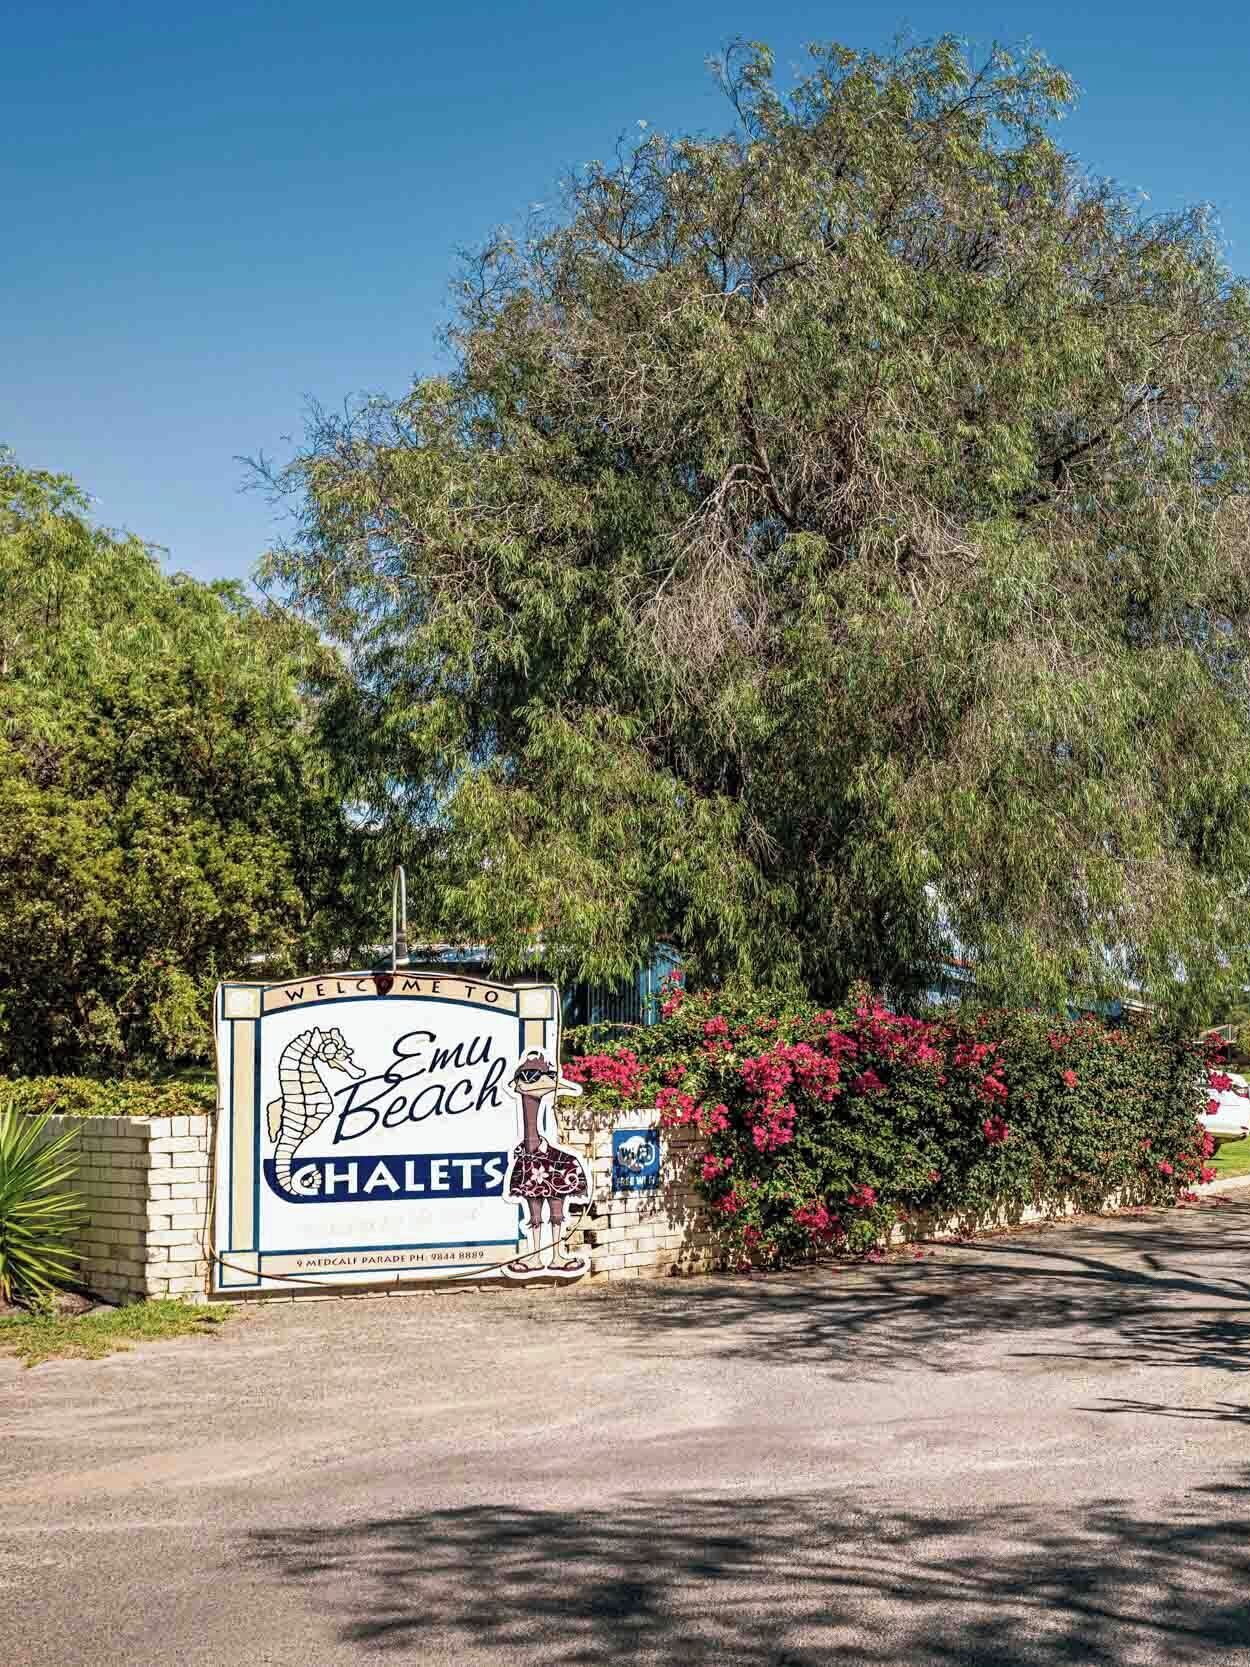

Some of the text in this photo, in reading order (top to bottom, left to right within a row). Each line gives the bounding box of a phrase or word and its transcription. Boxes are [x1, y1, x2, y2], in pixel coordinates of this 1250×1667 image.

[286, 979, 499, 1003] WELCME TO
[384, 1030, 493, 1085] Emu
[333, 1057, 508, 1145] Beach
[291, 1158, 504, 1197] CHALETS
[362, 1254, 405, 1264] PARADE
[431, 1252, 455, 1261] 9844
[459, 1251, 484, 1260] 8889
